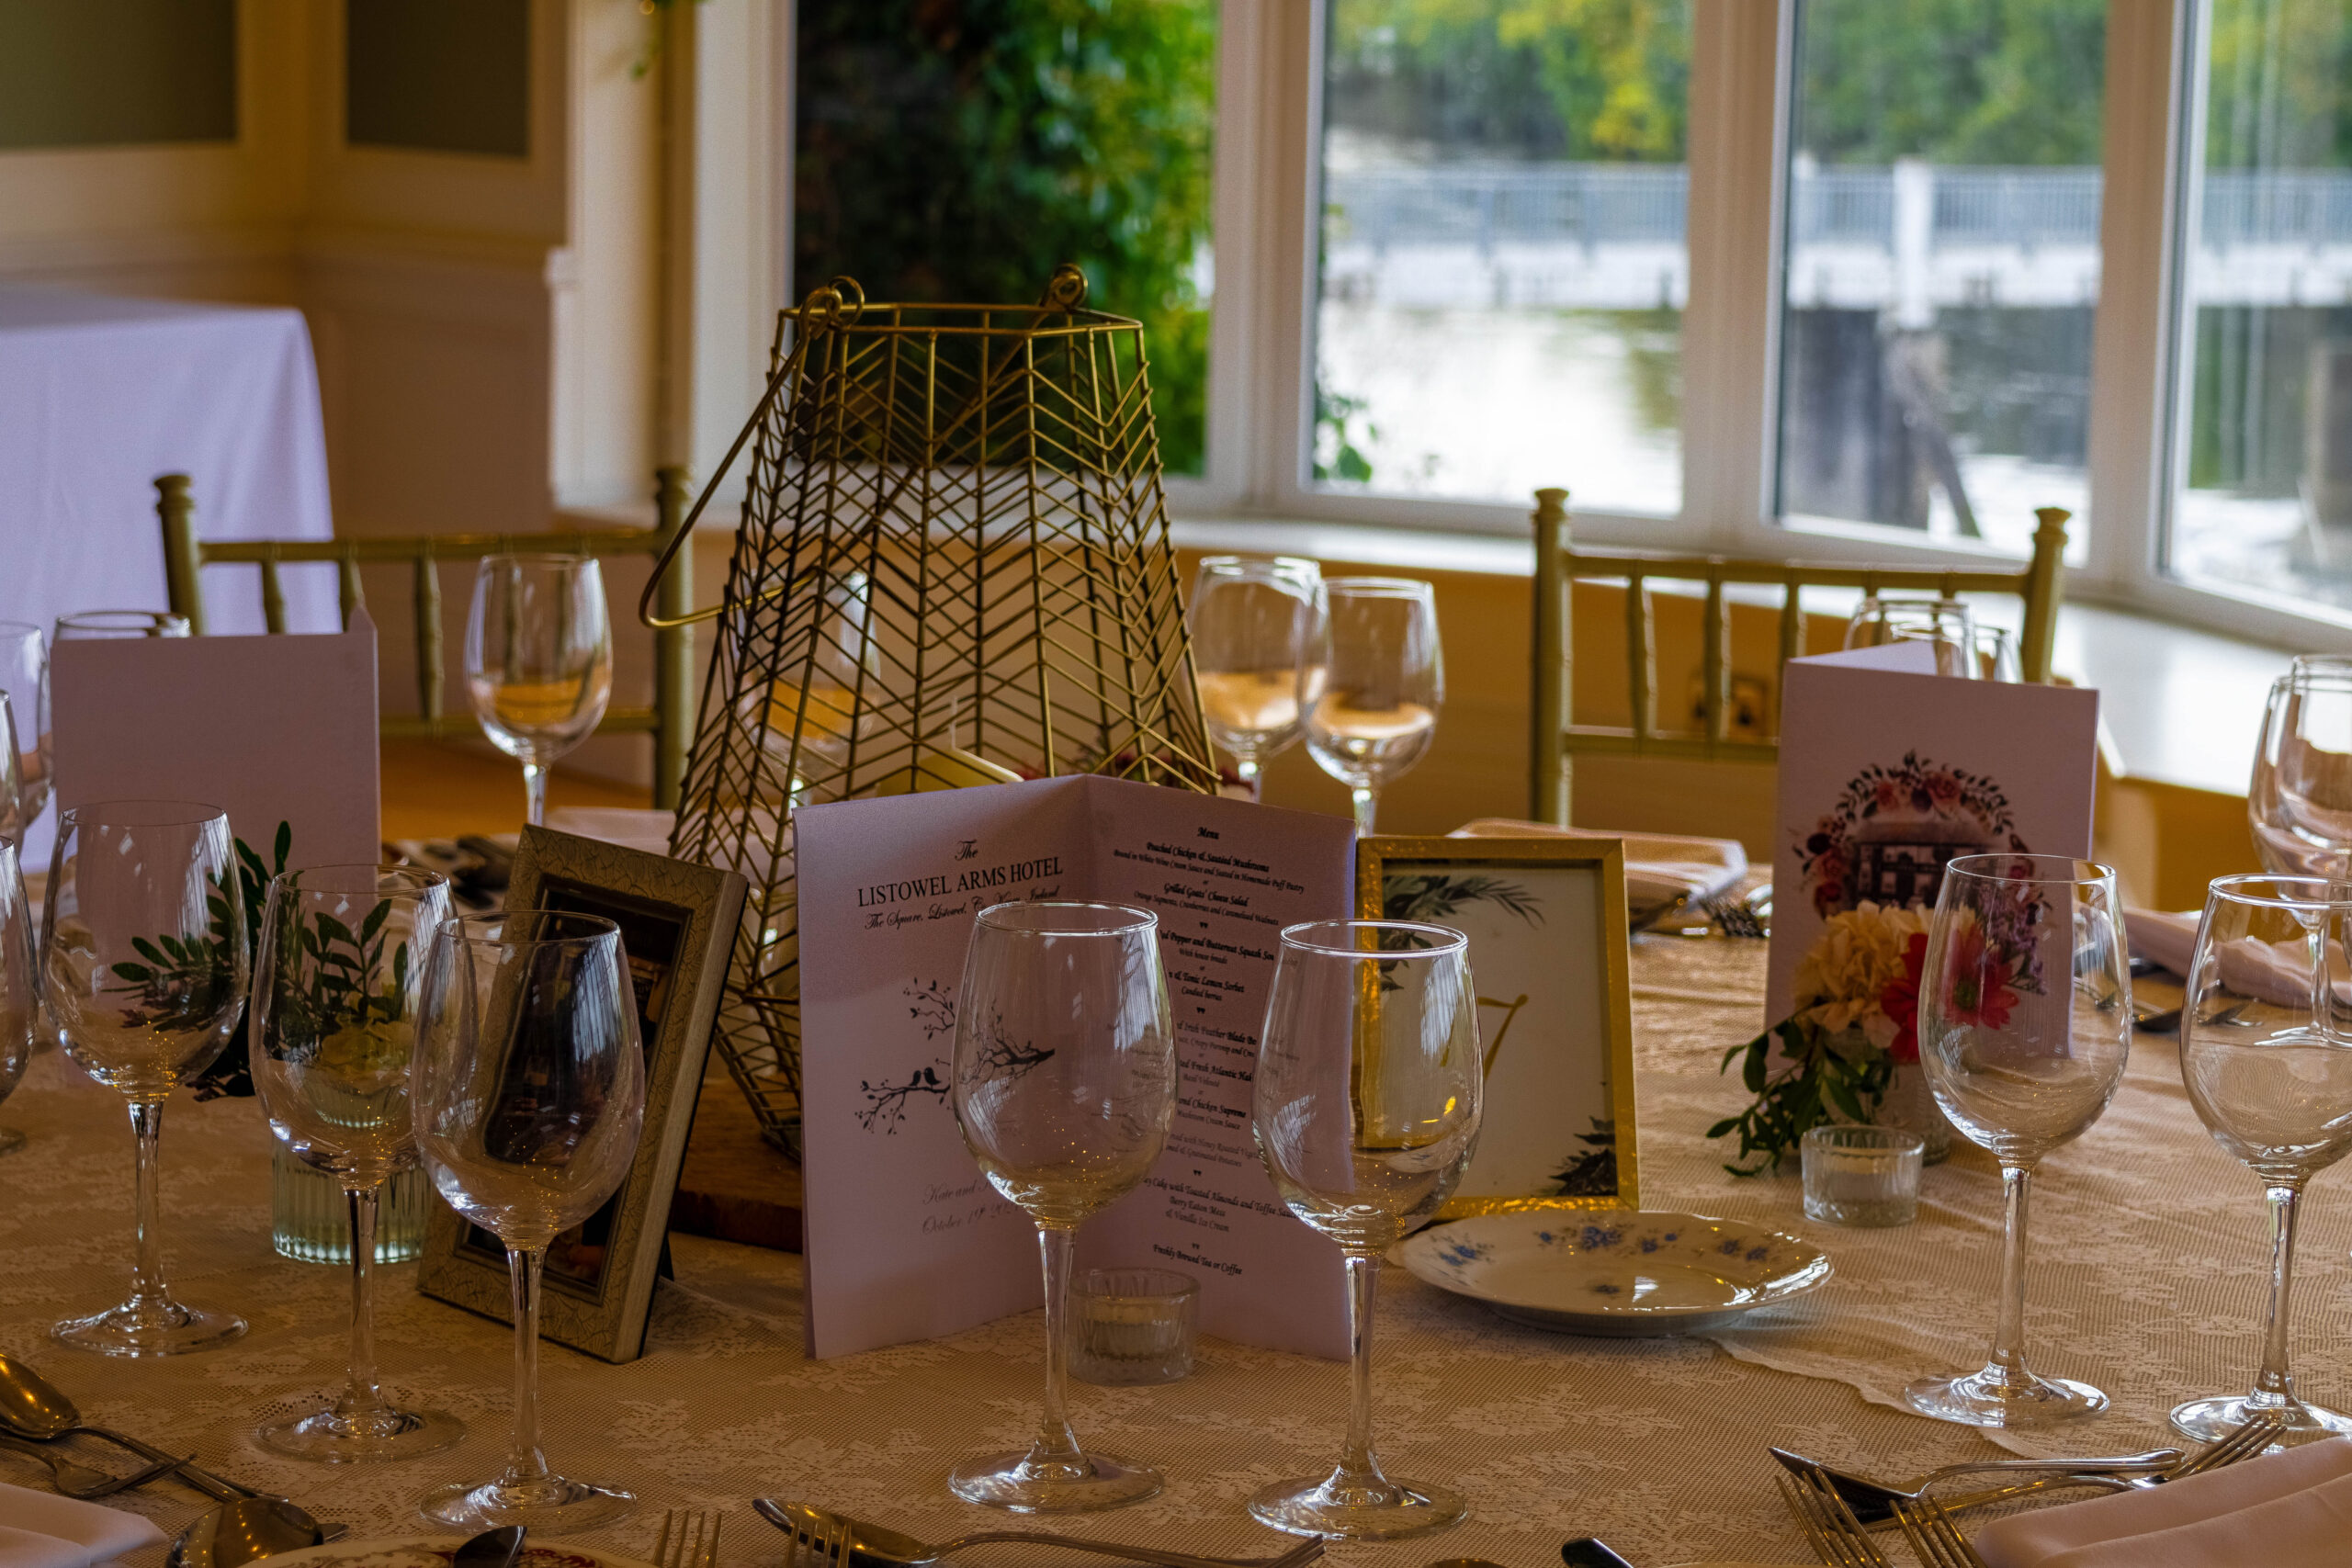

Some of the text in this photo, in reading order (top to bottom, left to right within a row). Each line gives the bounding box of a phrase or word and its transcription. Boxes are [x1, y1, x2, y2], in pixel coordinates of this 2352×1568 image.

[1197, 826, 1219, 840] Menu
[955, 839, 978, 861] The
[1146, 841, 1172, 854] Poached
[1172, 845, 1196, 860] Chicken
[1232, 857, 1270, 873] Mushrooms
[858, 856, 1063, 907] LISTOWEL ARMS HOTEL
[1170, 859, 1187, 871] Cream
[1204, 866, 1216, 875] and
[1240, 873, 1272, 886] Homemade
[1272, 879, 1287, 891] Puff
[1285, 882, 1305, 895] Pastry
[1164, 883, 1186, 894] Grilled
[1207, 891, 1229, 904] Cheese
[1229, 896, 1250, 908] Salad
[865, 912, 884, 931] The
[1209, 906, 1222, 916] and
[1253, 913, 1279, 926] Walnuts
[1170, 931, 1192, 946] Pepper
[1192, 937, 1205, 948] and
[1205, 939, 1238, 954] Butternut
[1237, 945, 1261, 959] Squash
[1182, 972, 1201, 985] Tonic
[1201, 976, 1223, 988] Lemon
[1223, 981, 1245, 994] Sorbet
[1201, 1025, 1227, 1039] Feather
[1227, 1031, 1246, 1043] Blade
[1230, 1047, 1244, 1055] and
[1191, 1061, 1209, 1073] Fresh
[1209, 1065, 1238, 1079] Atlantic
[1192, 1099, 1218, 1113] Chicken
[1218, 1104, 1248, 1119] Supreme
[955, 1179, 978, 1198] and
[1169, 1181, 1185, 1194] with
[1185, 1186, 1210, 1201] Toasted
[1210, 1190, 1239, 1208] Almonds
[1239, 1199, 1255, 1211] and
[1254, 1200, 1277, 1217] Toffee
[1169, 1195, 1188, 1211] Berry
[1208, 1204, 1227, 1218] Mess
[922, 1215, 963, 1236] October
[1173, 1210, 1198, 1225] Vanilla
[1197, 1215, 1209, 1227] Ice
[1209, 1219, 1230, 1233] Cream
[1152, 1244, 1176, 1260] Freshly
[1176, 1250, 1202, 1266] Brewed
[1200, 1256, 1213, 1269] Tea
[1221, 1262, 1243, 1277] Coffee
